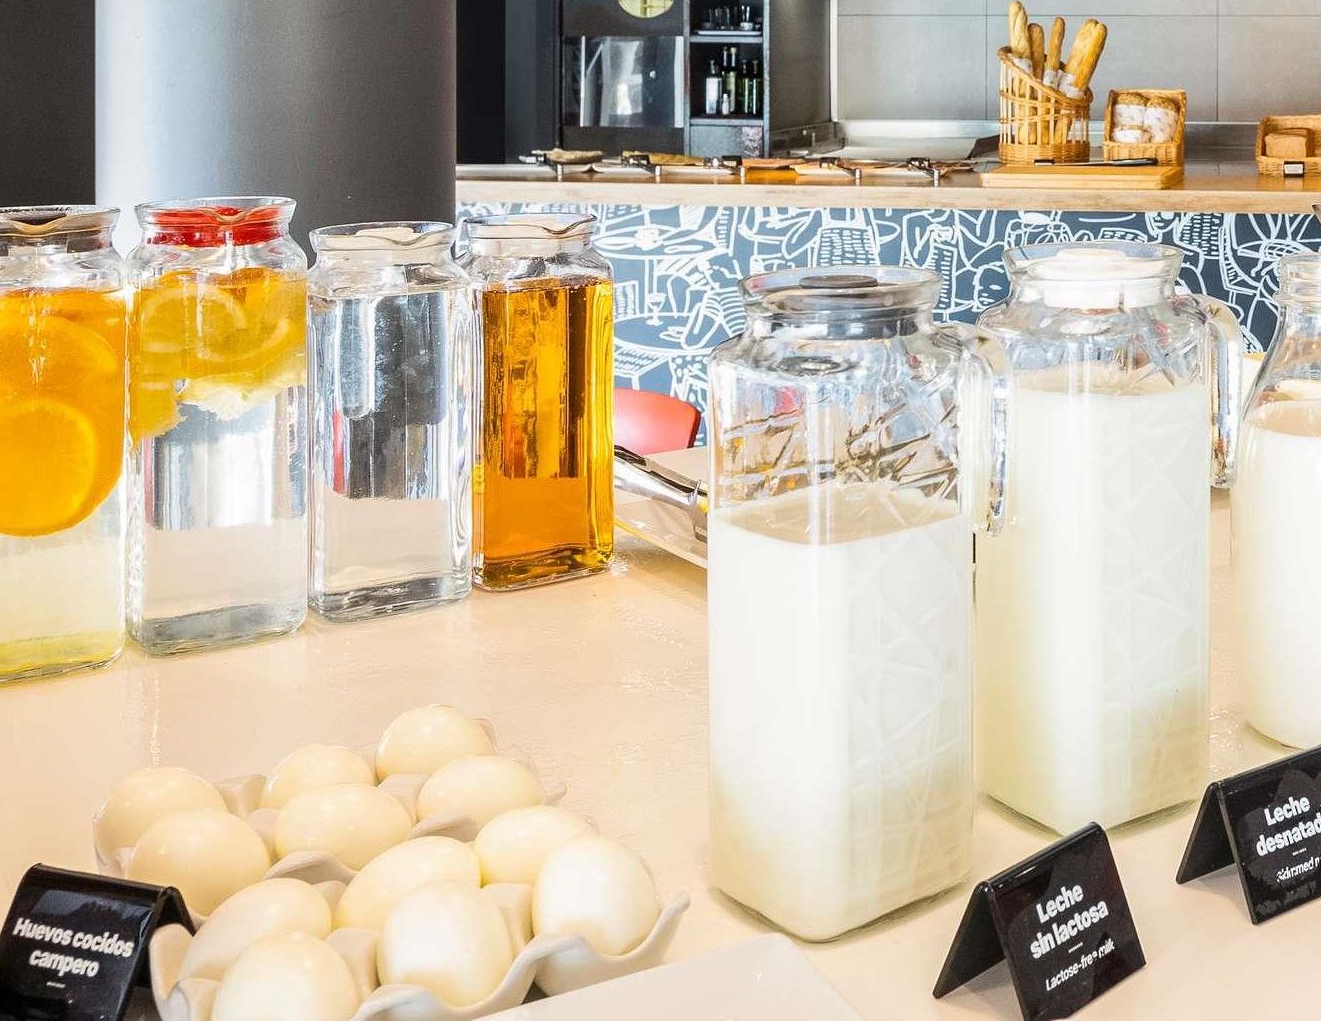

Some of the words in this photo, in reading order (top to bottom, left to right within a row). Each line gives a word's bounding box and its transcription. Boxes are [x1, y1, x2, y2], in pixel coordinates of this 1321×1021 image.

[1264, 796, 1311, 826] Leche
[1036, 884, 1084, 924] Leche
[12, 917, 73, 946] Huevos
[71, 931, 135, 958] cocidos
[1030, 932, 1056, 959] sin
[1051, 900, 1109, 946] lactosa
[29, 949, 100, 977] campero
